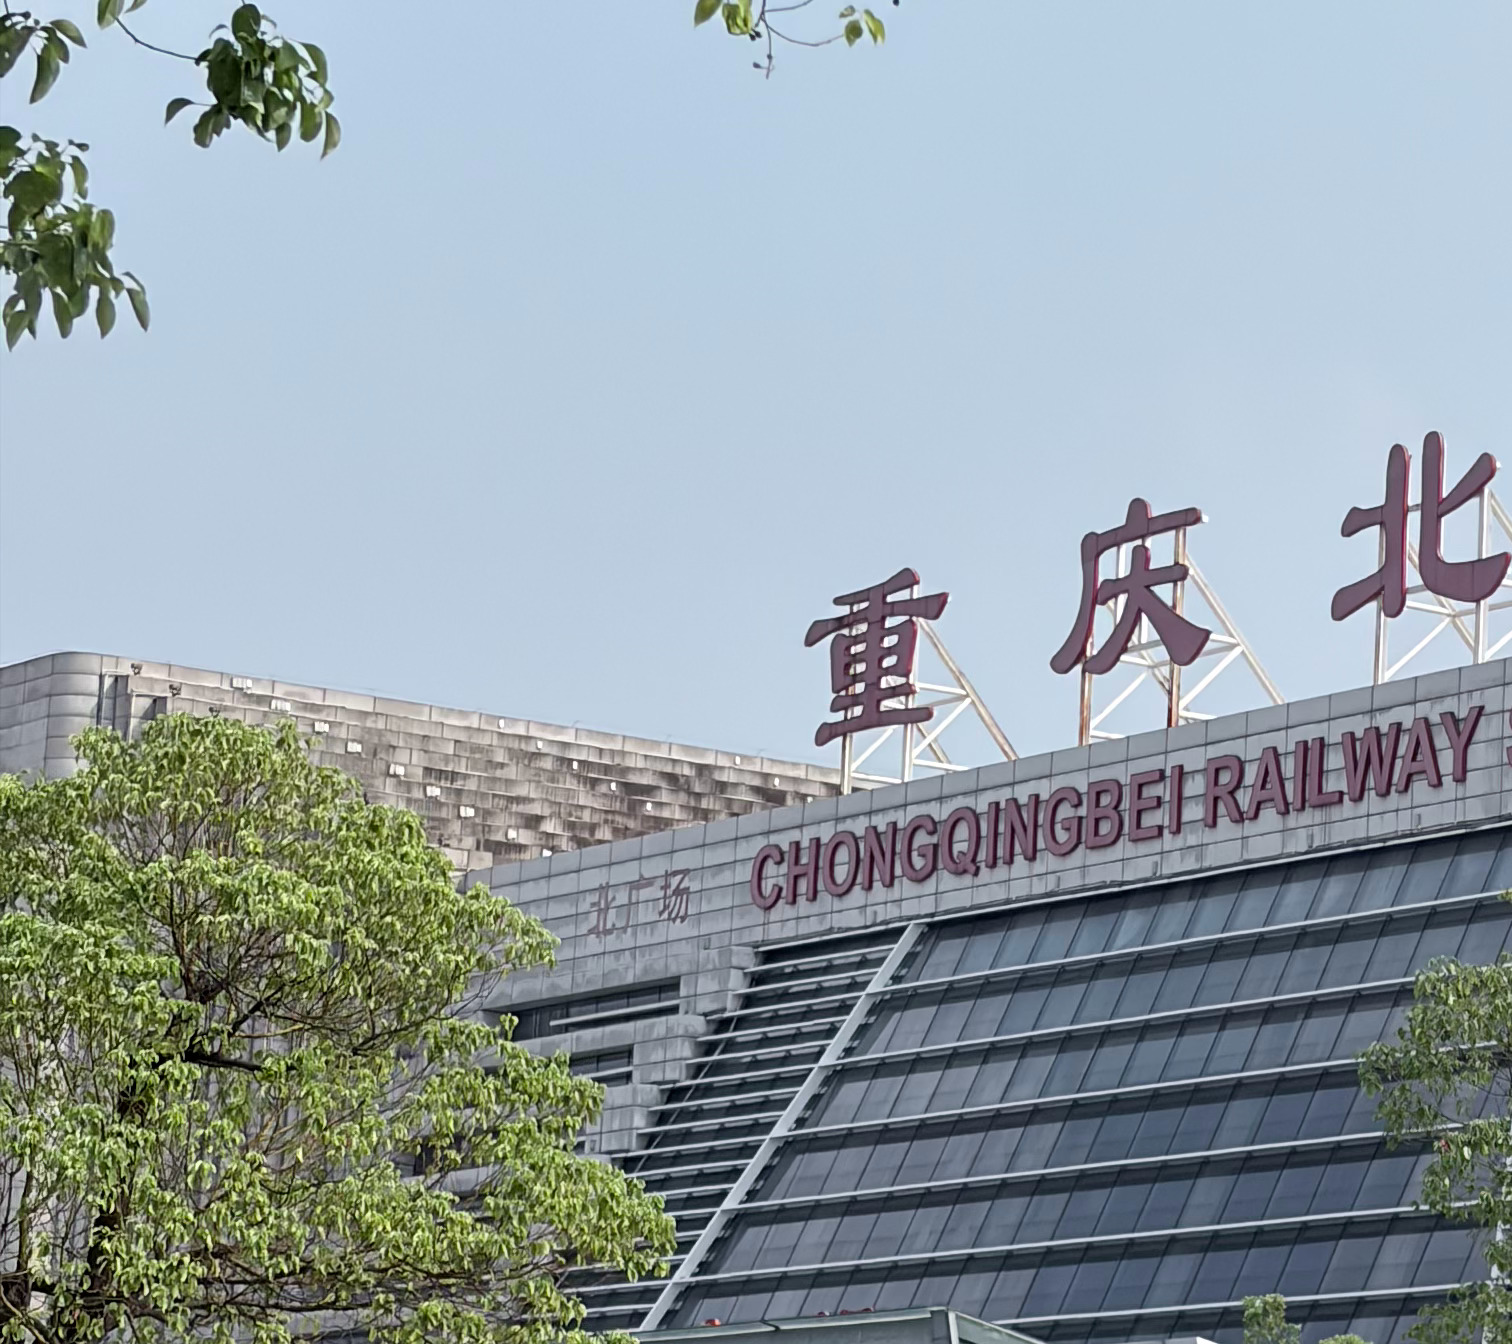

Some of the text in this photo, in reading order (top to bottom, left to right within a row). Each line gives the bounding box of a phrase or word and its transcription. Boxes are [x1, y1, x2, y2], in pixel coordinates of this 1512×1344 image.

[750, 764, 1184, 911] CHONGQINGBEI
[1204, 705, 1485, 828] RAILWAY
[586, 867, 692, 939] 北广场
